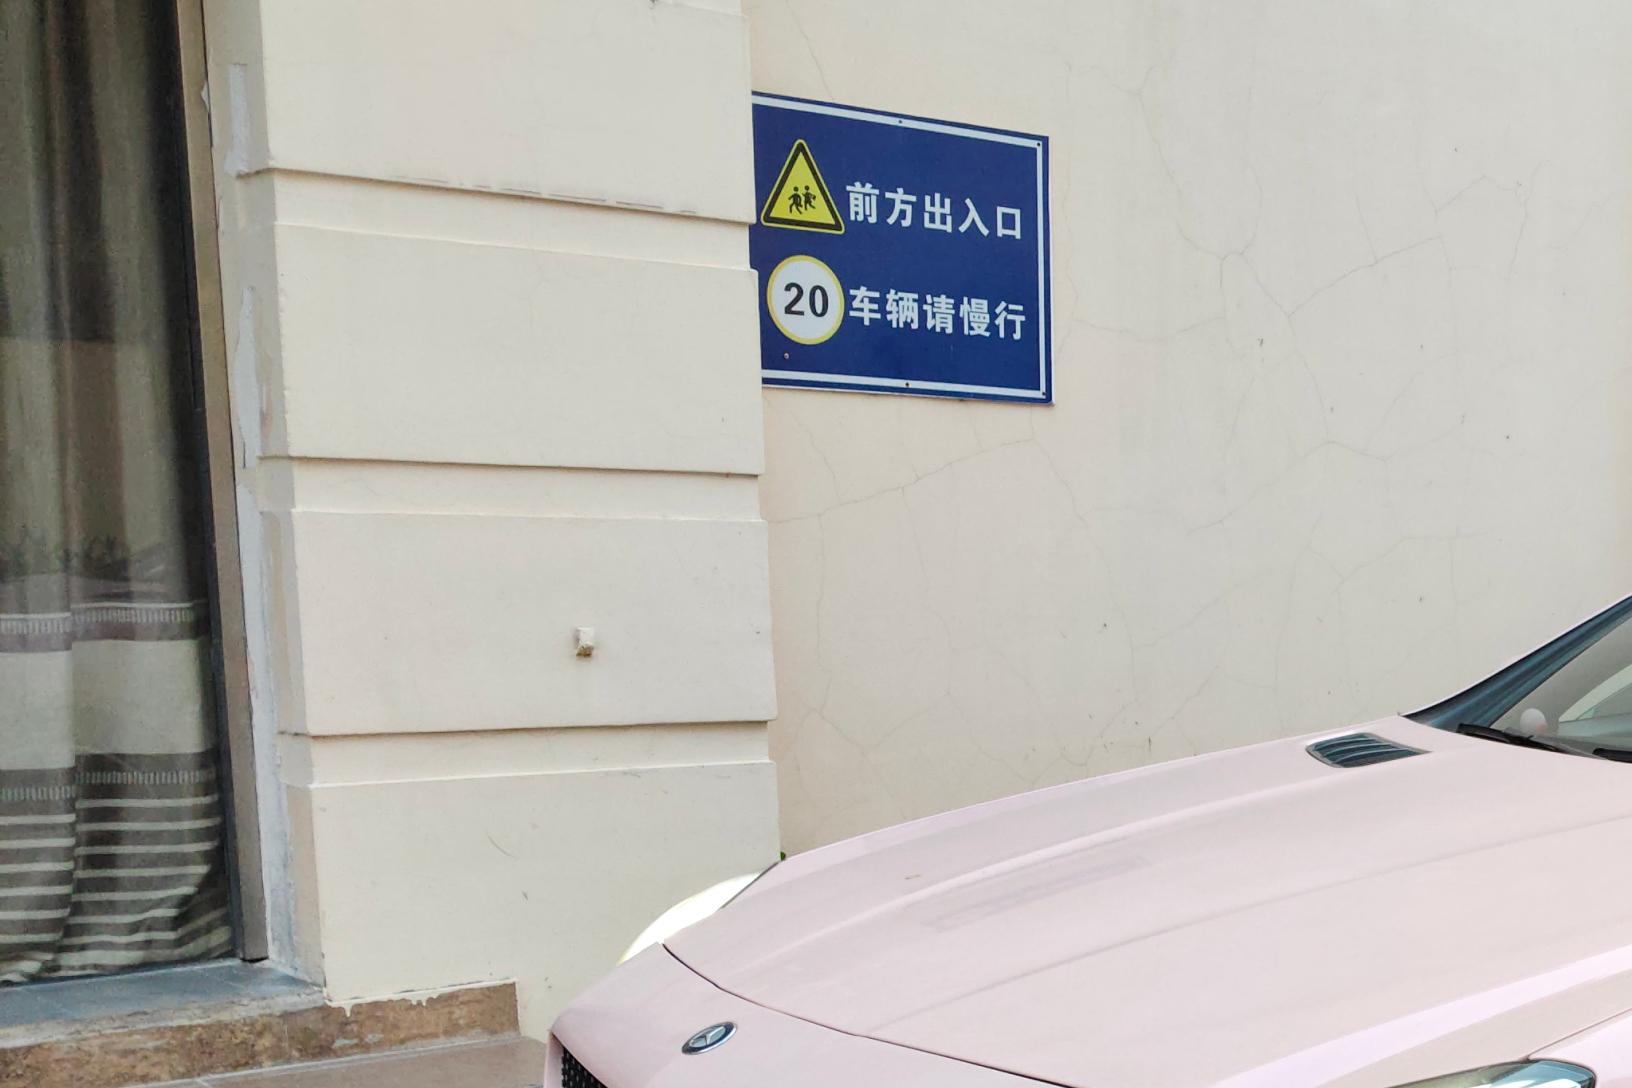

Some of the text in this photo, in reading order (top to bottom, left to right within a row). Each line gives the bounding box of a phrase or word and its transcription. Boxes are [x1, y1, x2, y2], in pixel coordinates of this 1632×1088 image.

[845, 181, 1022, 240] 前方出入口
[783, 281, 830, 318] 20
[848, 285, 1026, 341] 车辆请慢行
